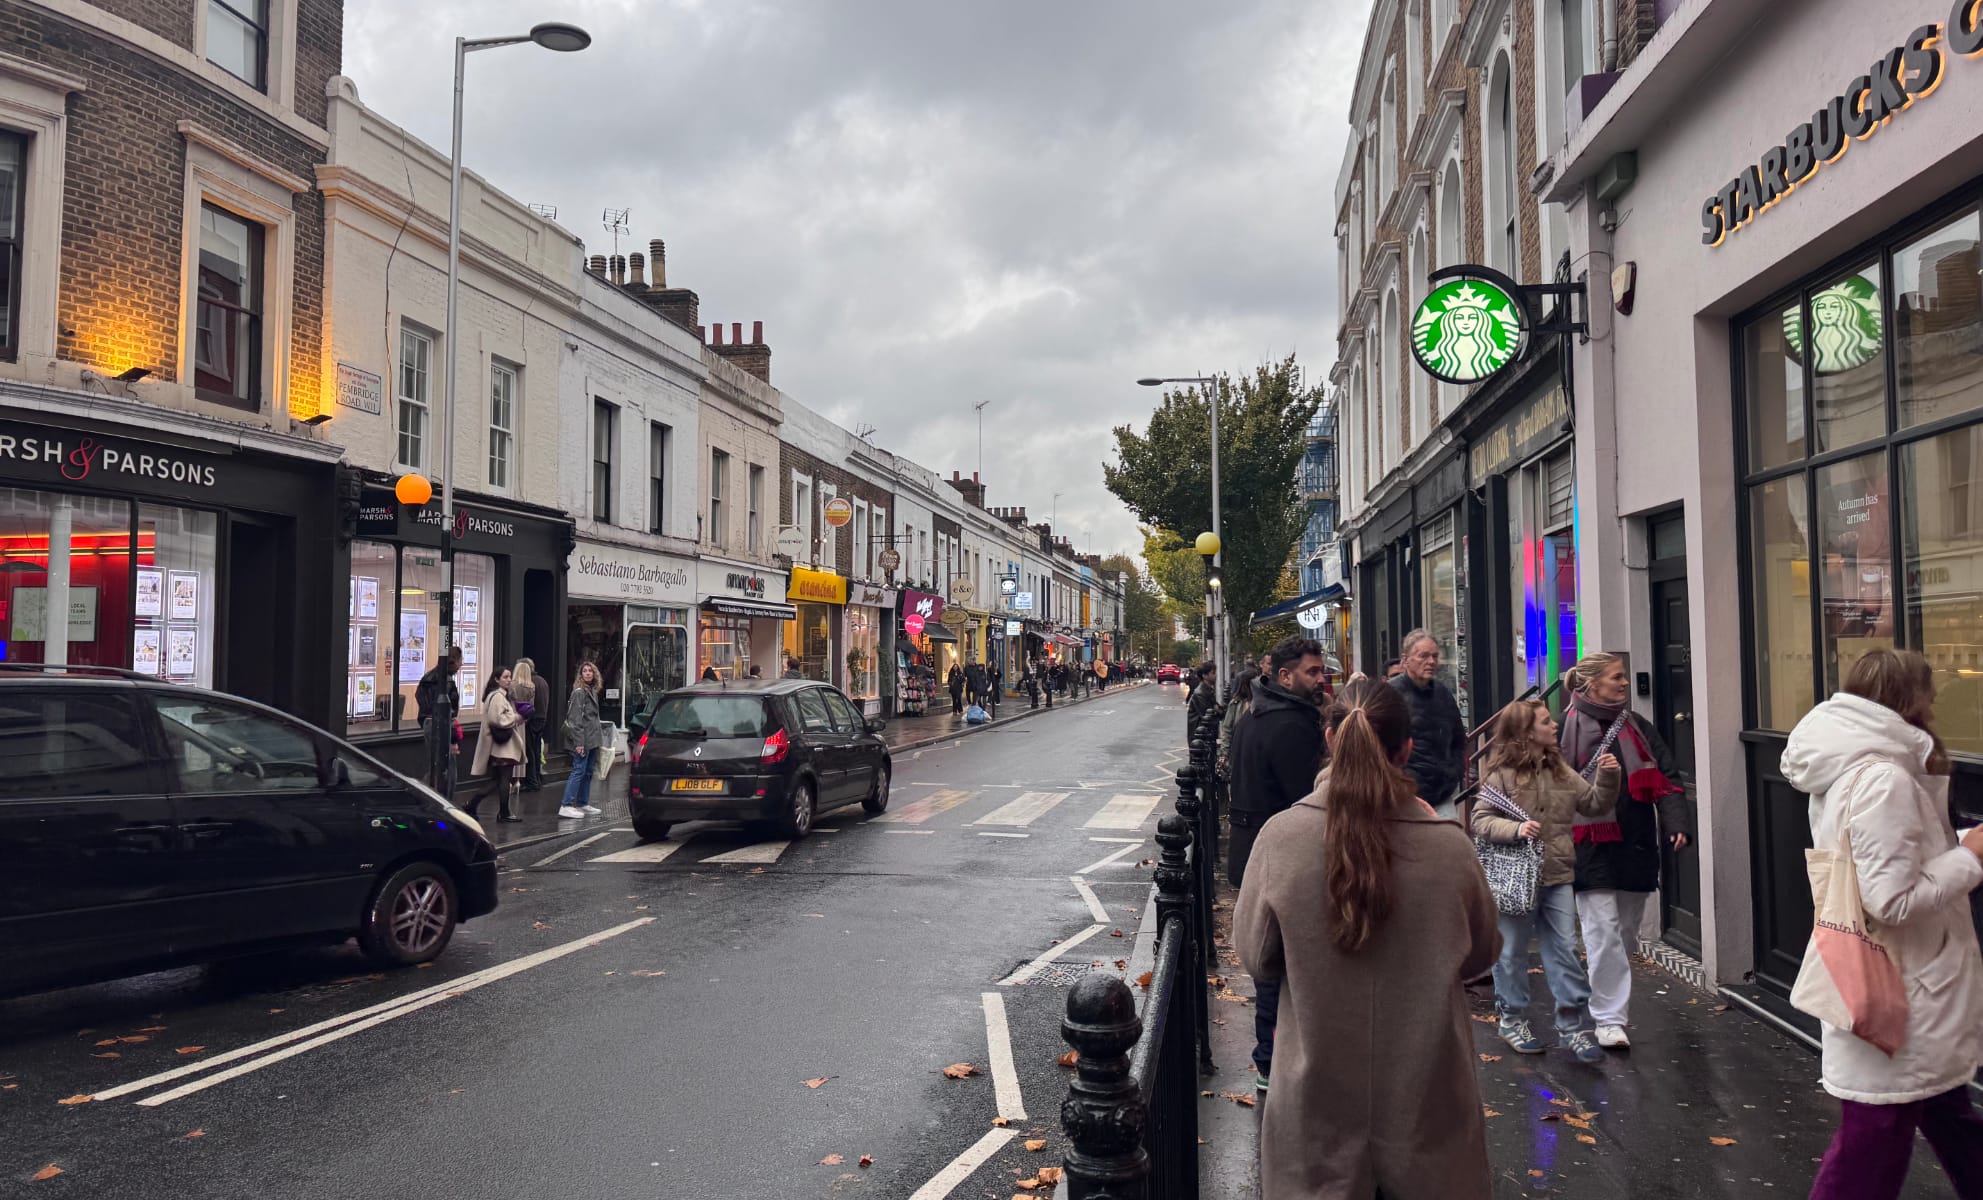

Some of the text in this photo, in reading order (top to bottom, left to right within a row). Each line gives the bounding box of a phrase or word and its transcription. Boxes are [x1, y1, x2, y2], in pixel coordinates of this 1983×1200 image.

[1702, 24, 1942, 245] STARBUCKS
[339, 382, 379, 402] PEMBRIDGE
[341, 393, 376, 411] ROAD W11
[61, 437, 104, 480] &
[103, 449, 215, 486] PARSONS
[1839, 492, 1878, 511] Autumn has
[417, 508, 514, 539] MARH & PARSONS
[1846, 508, 1870, 525] arrived
[578, 555, 687, 589] Sebastiano Barbagallo
[676, 780, 718, 790] LJ08 GLF
